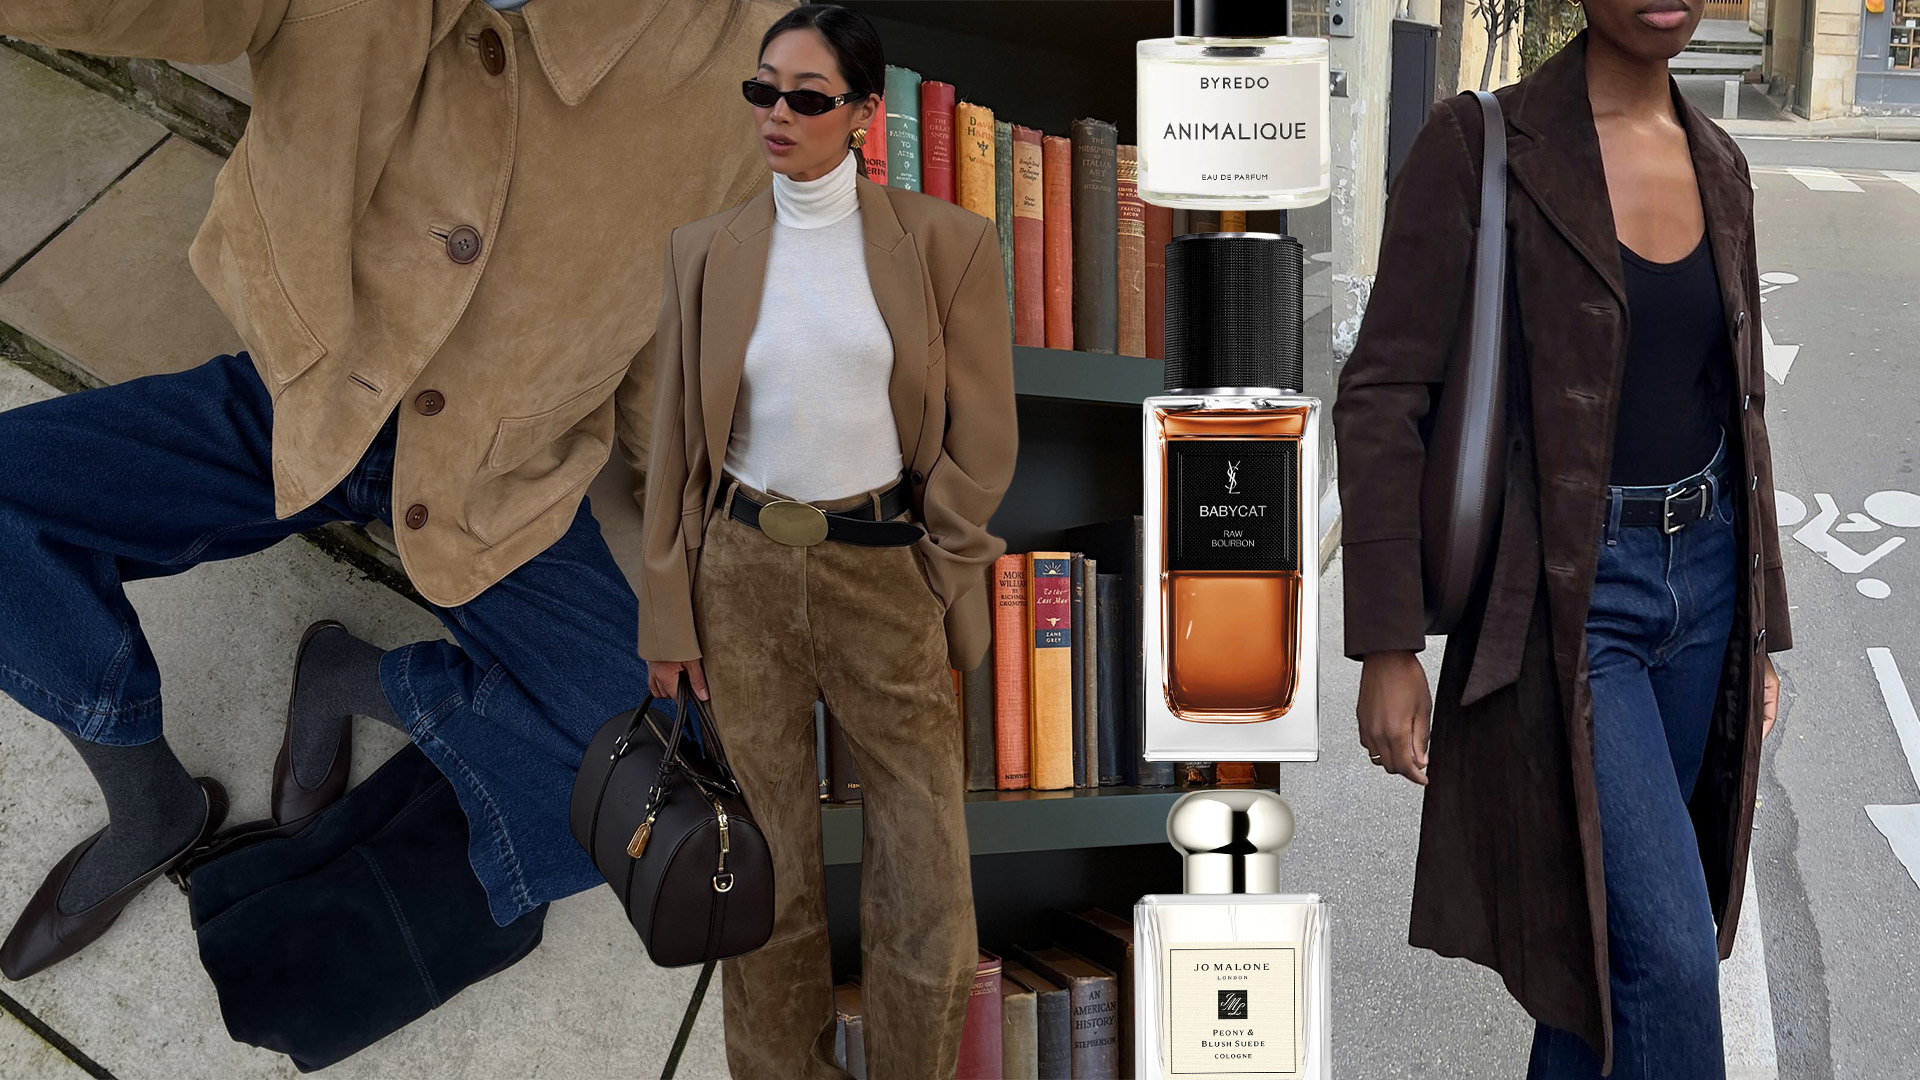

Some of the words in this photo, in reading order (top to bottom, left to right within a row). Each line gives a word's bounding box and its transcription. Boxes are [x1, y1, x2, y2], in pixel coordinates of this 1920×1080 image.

[1200, 77, 1270, 90] BYREDO
[929, 124, 950, 133] GREAT
[1163, 122, 1307, 141] ANIMALIQUE
[900, 140, 911, 149] TO
[1082, 159, 1112, 169] ITALIAN
[1088, 169, 1107, 177] ART
[1199, 505, 1267, 517] BABYCAT
[1223, 530, 1243, 538] RAW
[1211, 539, 1255, 548] BOURBON
[1036, 597, 1052, 605] Last
[1194, 963, 1210, 972] JO
[1213, 963, 1270, 971] MALONE
[1089, 990, 1101, 1000] AN
[1073, 1001, 1117, 1016] AMERICAN
[1075, 1016, 1115, 1030] HISTORY
[1247, 1028, 1254, 1036] &
[1074, 1036, 1117, 1049] STEPHENSON
